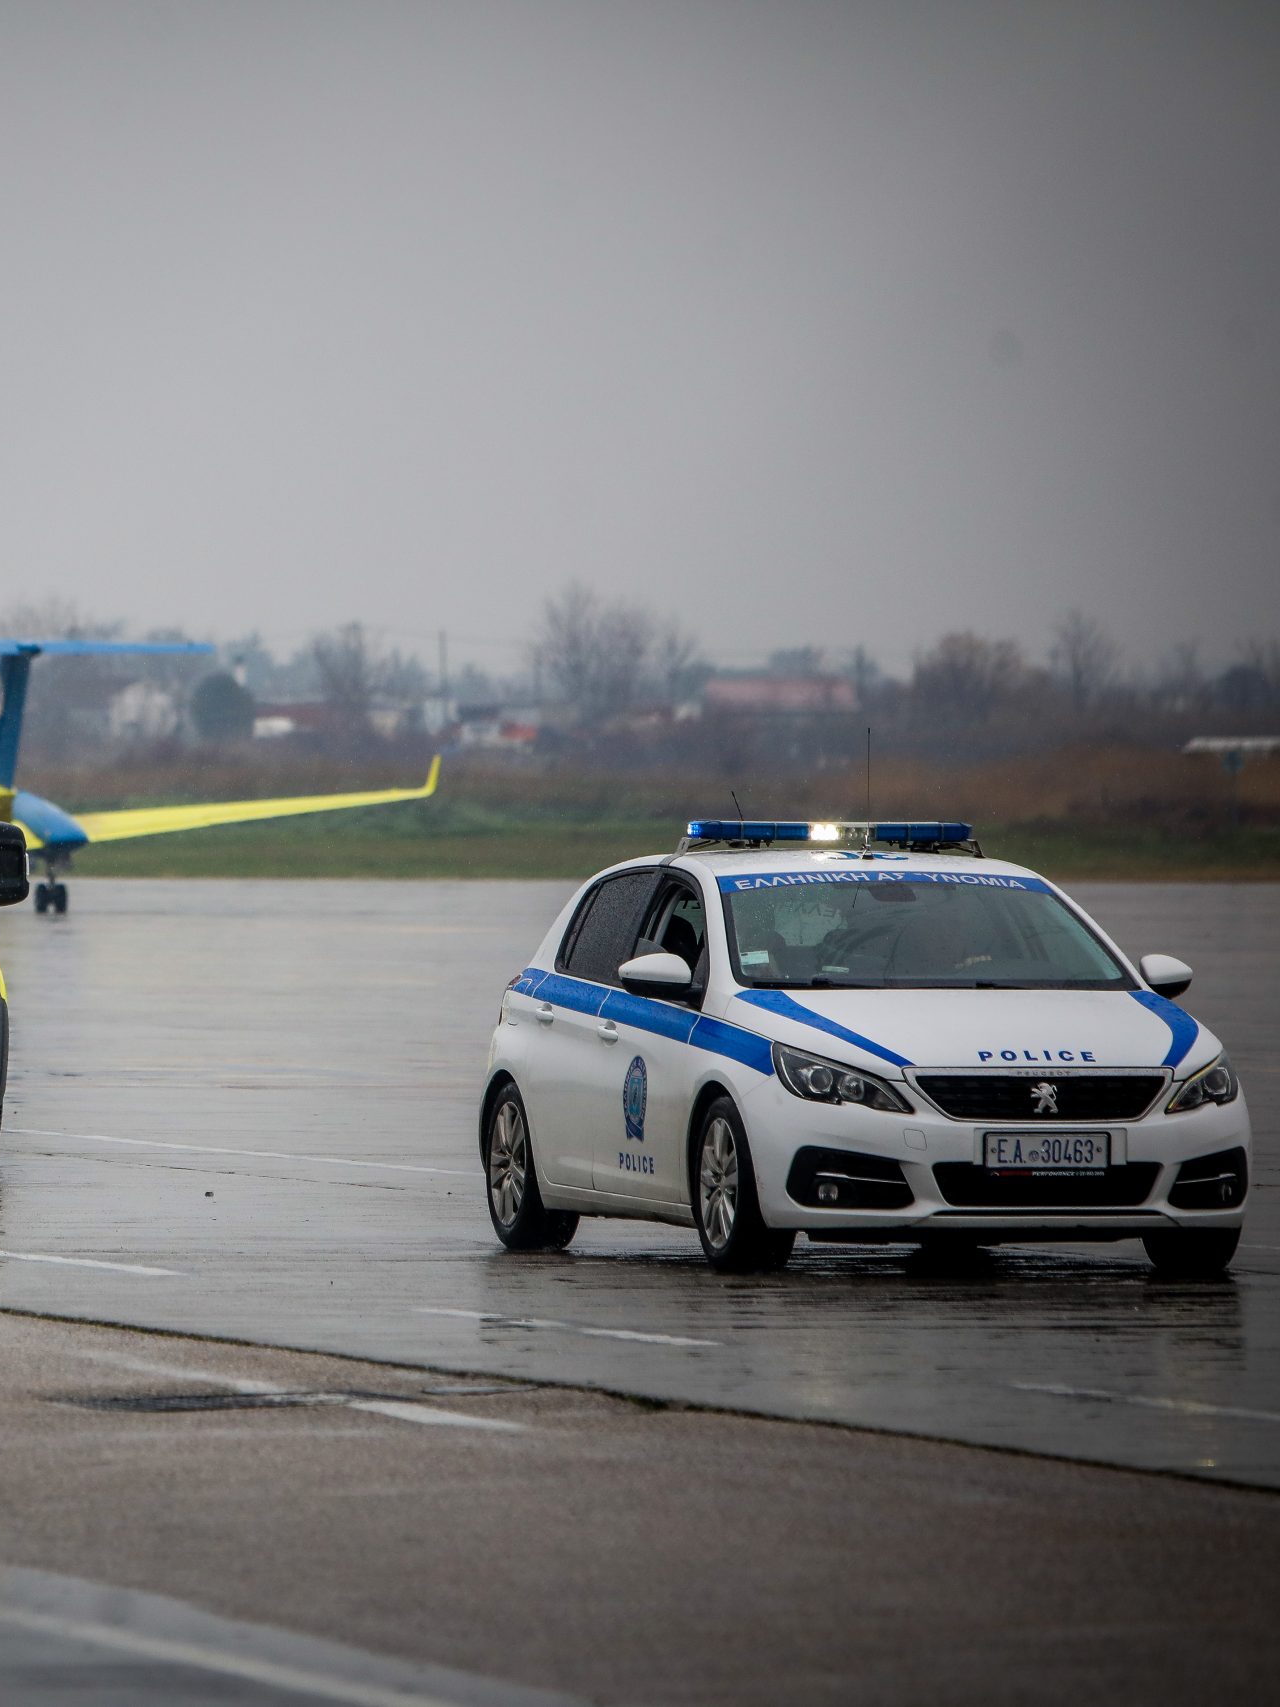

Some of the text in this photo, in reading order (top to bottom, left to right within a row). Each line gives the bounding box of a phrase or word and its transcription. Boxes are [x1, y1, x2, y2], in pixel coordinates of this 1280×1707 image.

[734, 872, 1027, 891] ΕΛΛΗΝΙΚΗ ΑΣΥΝΟΜΙΑ
[978, 1050, 1097, 1062] POLICE
[1041, 1139, 1094, 1164] 30463
[619, 1152, 655, 1175] POLICE
